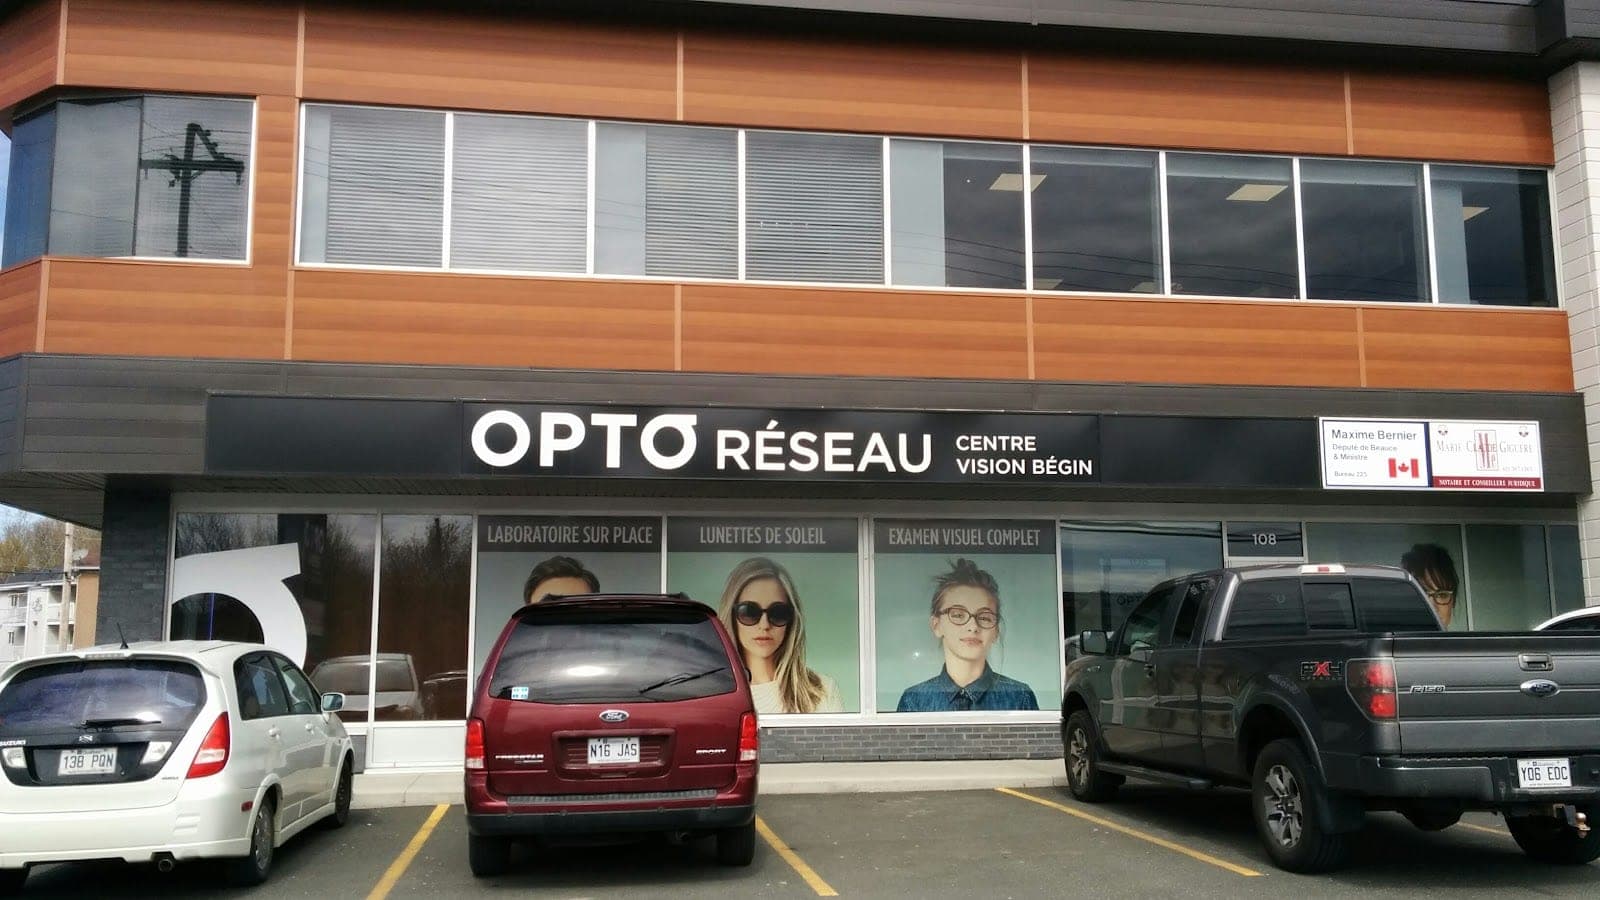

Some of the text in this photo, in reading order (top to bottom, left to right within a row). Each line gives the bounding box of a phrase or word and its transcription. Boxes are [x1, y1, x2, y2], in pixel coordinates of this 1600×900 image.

[1331, 429, 1417, 441] Maxime Bernier
[717, 420, 932, 473] RÉSEAU
[956, 435, 1037, 453] CENTRE
[1370, 444, 1398, 452] Beauce
[957, 455, 1093, 477] VISION BÉGIN
[487, 525, 653, 543] LABORATOIRE SUR PLACE
[700, 526, 826, 544] LUNETTES DE SOLEIL
[889, 528, 1041, 546] EXAMEN VISUEL COMPLET
[1252, 533, 1277, 545] 108
[590, 743, 638, 758] N16 JAS
[91, 754, 115, 768] PQN
[1521, 767, 1541, 781] Y06
